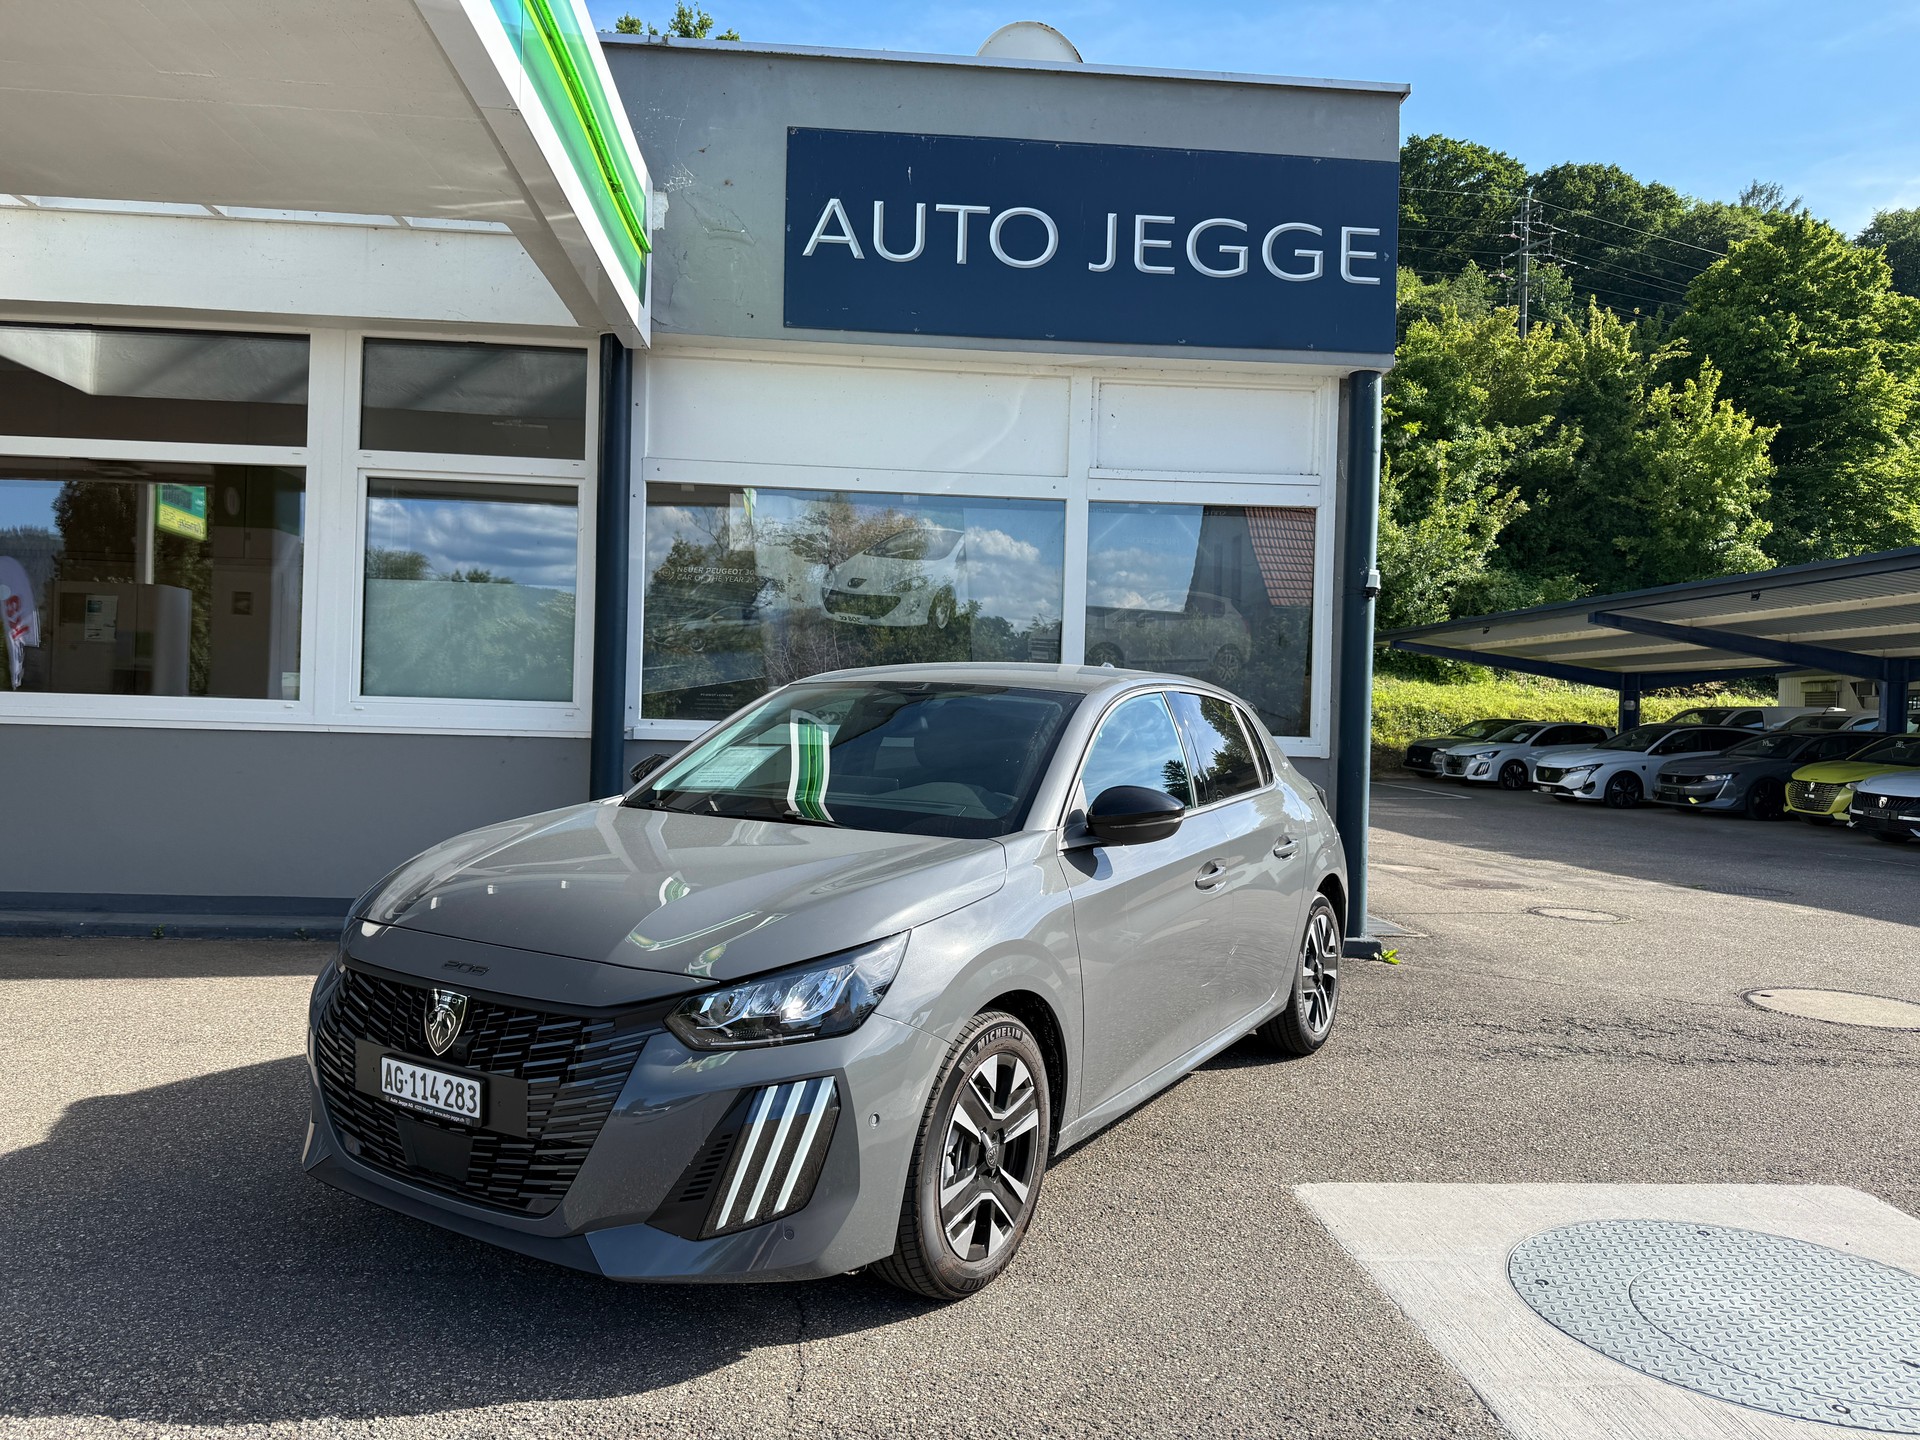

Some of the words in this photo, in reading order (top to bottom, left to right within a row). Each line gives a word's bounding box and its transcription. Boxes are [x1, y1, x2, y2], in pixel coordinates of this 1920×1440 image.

[802, 196, 1060, 269] AUTO
[1088, 212, 1382, 286] JEGGE
[676, 566, 704, 574] NEUER
[705, 567, 744, 575] PEUGEOT
[744, 568, 755, 576] 30
[676, 573, 693, 581] CAR
[694, 574, 704, 582] OF
[705, 574, 723, 582] THE
[724, 575, 744, 583] YEAR
[744, 576, 755, 584] 20
[443, 959, 491, 977] 208
[977, 1026, 1023, 1051] MICHELIN
